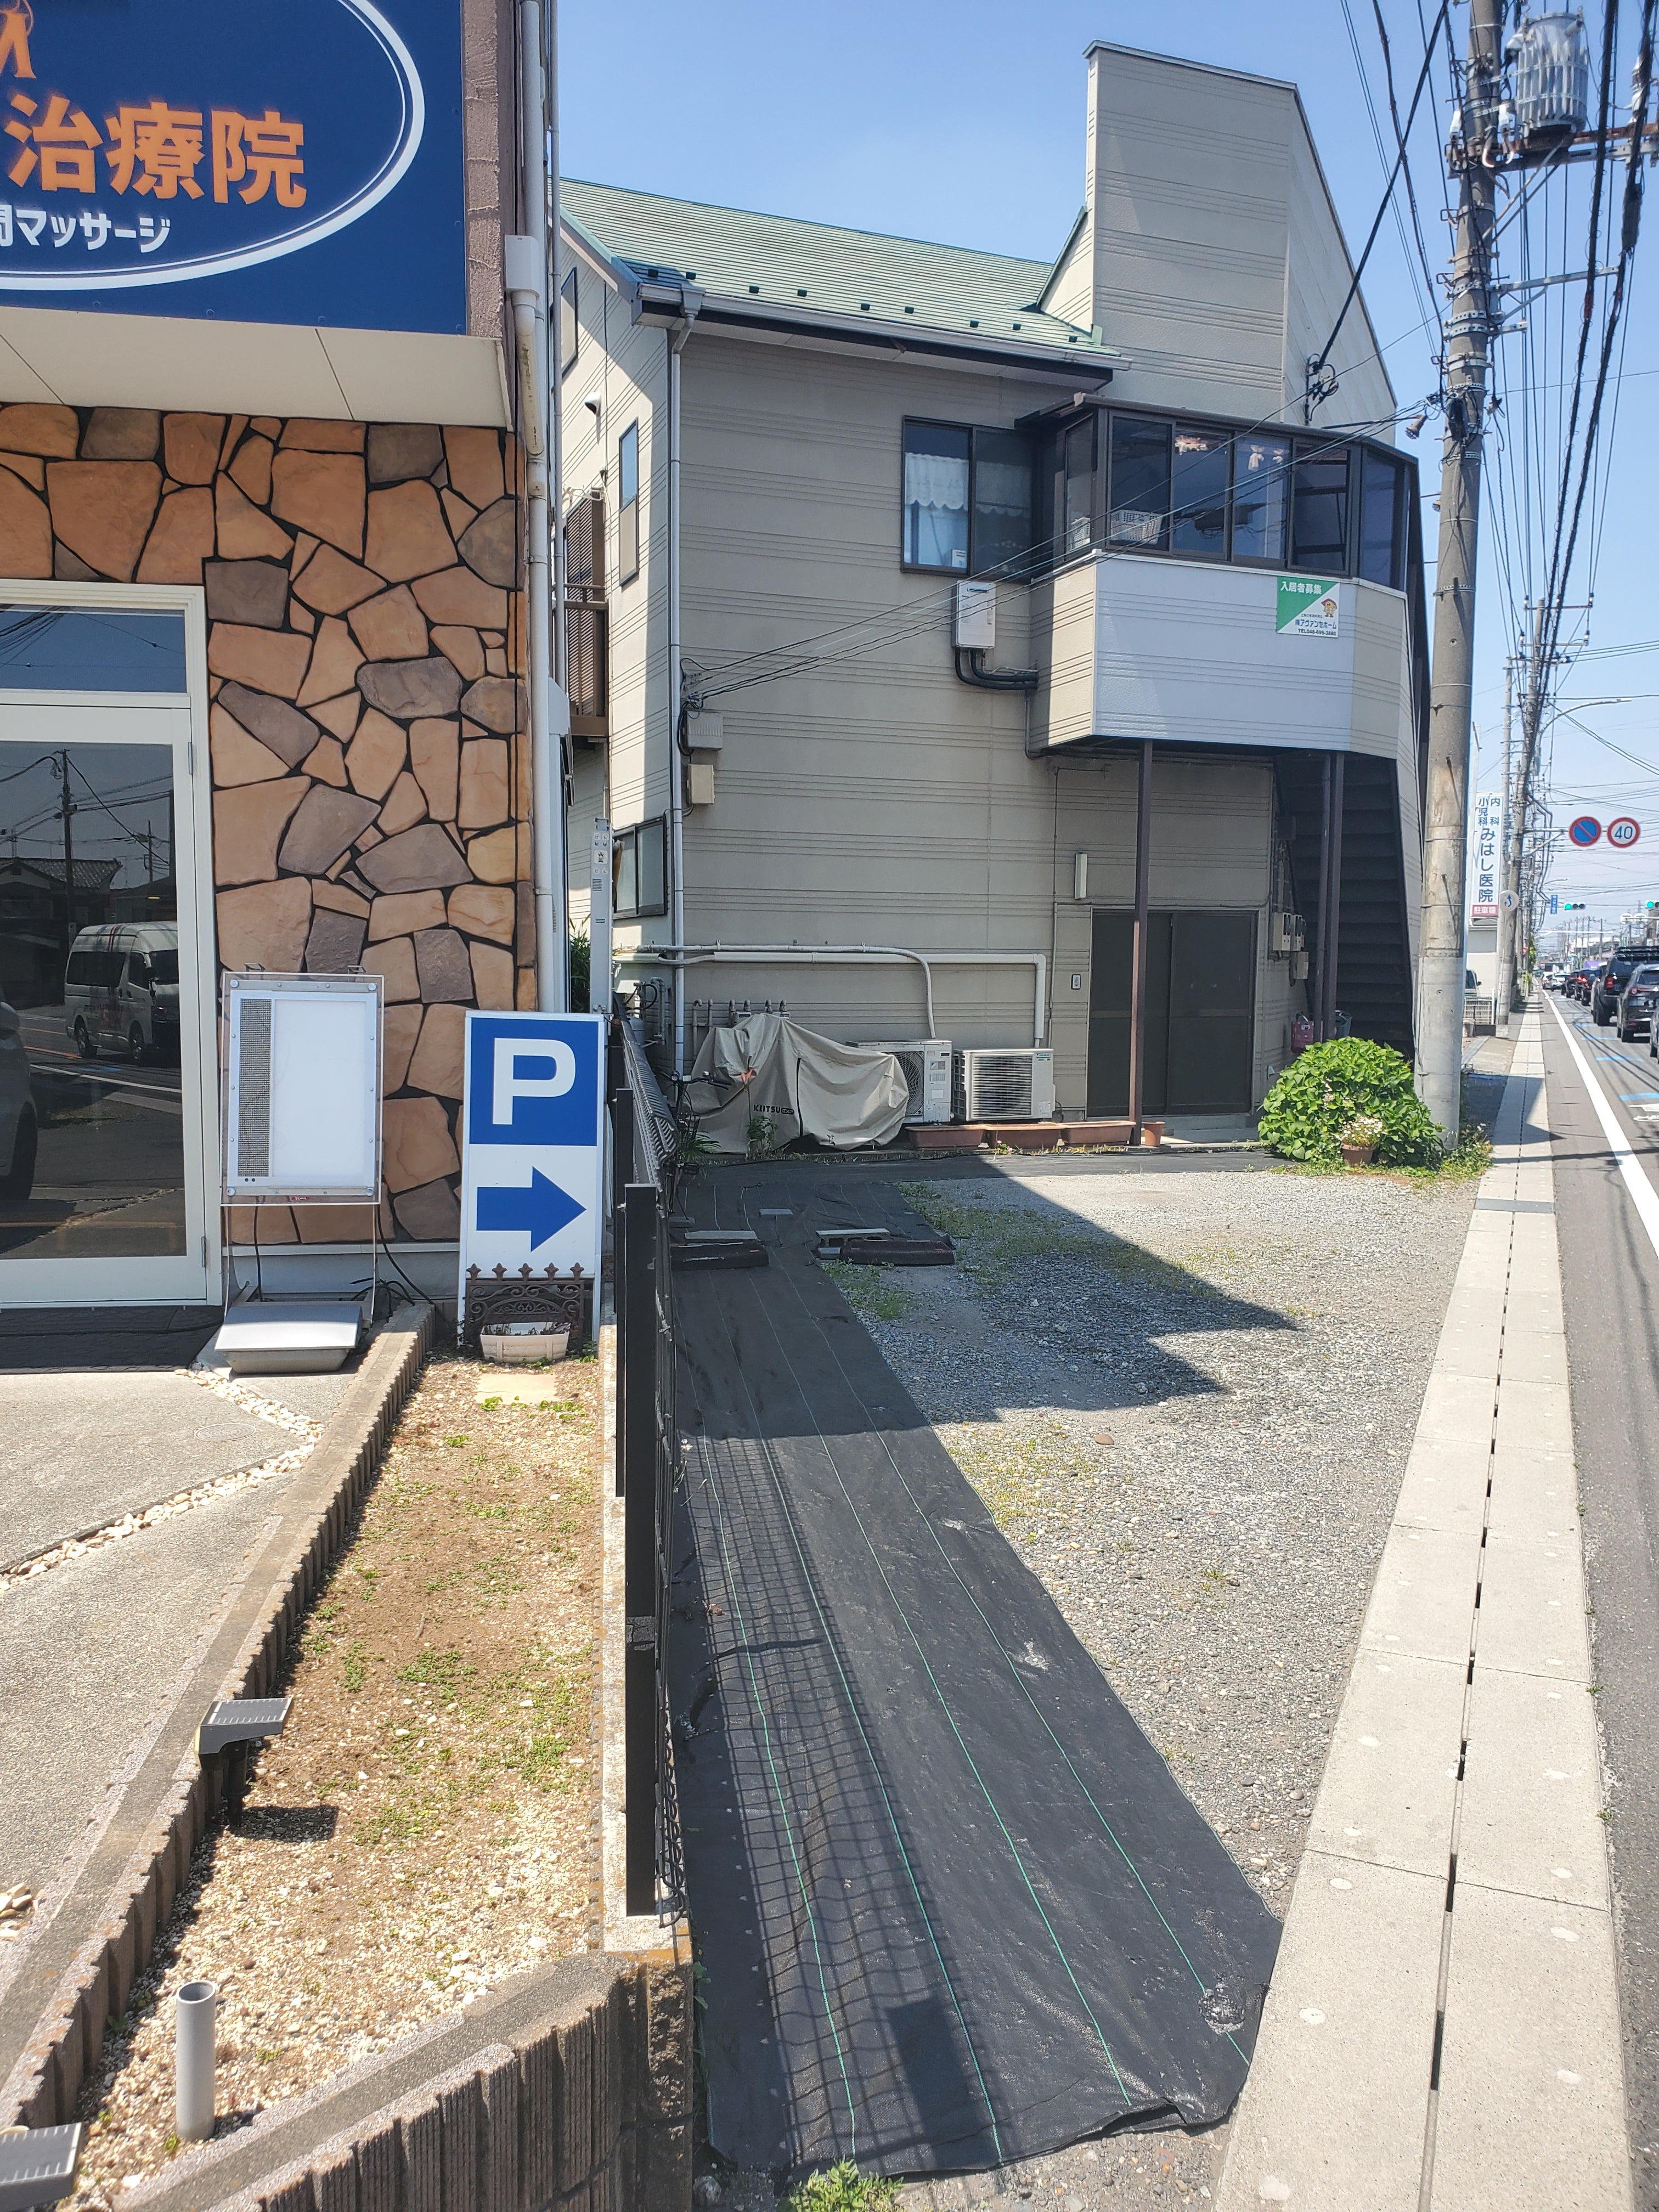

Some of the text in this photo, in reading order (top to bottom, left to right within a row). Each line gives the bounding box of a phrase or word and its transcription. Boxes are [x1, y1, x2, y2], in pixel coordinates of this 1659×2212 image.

[4, 92, 307, 208] 治療院
[1280, 581, 1322, 595] 入居者募集
[1478, 797, 1488, 826] 小児科
[1614, 825, 1633, 839] 40
[1479, 828, 1496, 902] みはし医院
[492, 1037, 576, 1125] P
[753, 1104, 781, 1114] KEITSU
